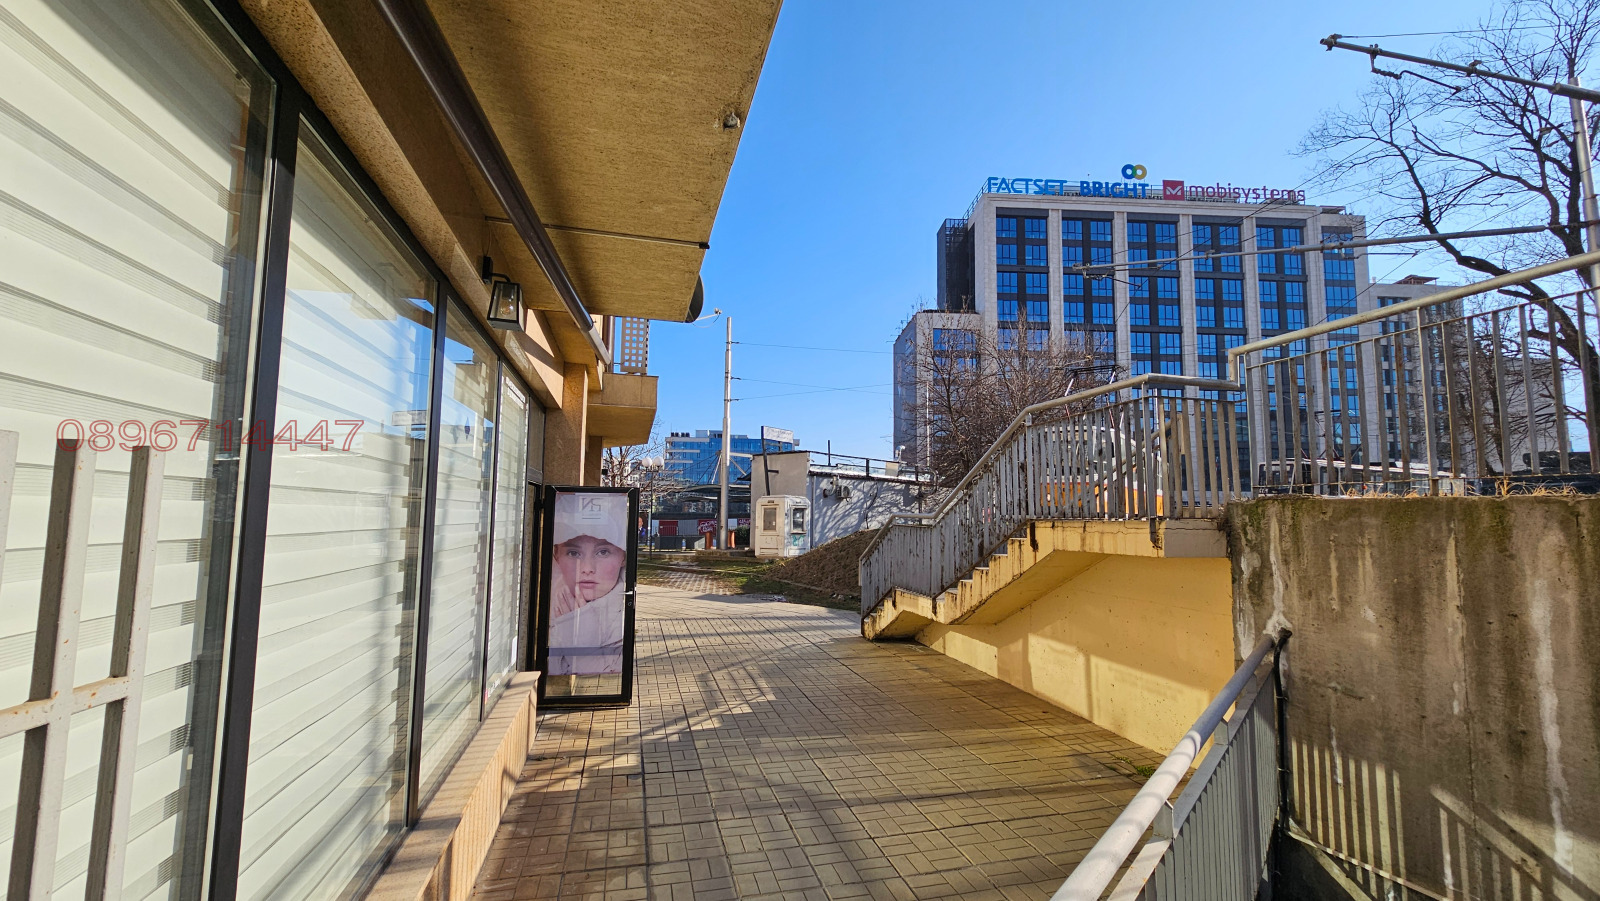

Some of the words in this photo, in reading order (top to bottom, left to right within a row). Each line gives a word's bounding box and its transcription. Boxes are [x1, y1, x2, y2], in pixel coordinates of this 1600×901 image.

[987, 176, 1068, 196] FACTSET
[1079, 180, 1149, 198] BRIGHT
[1188, 182, 1306, 204] mobisystems
